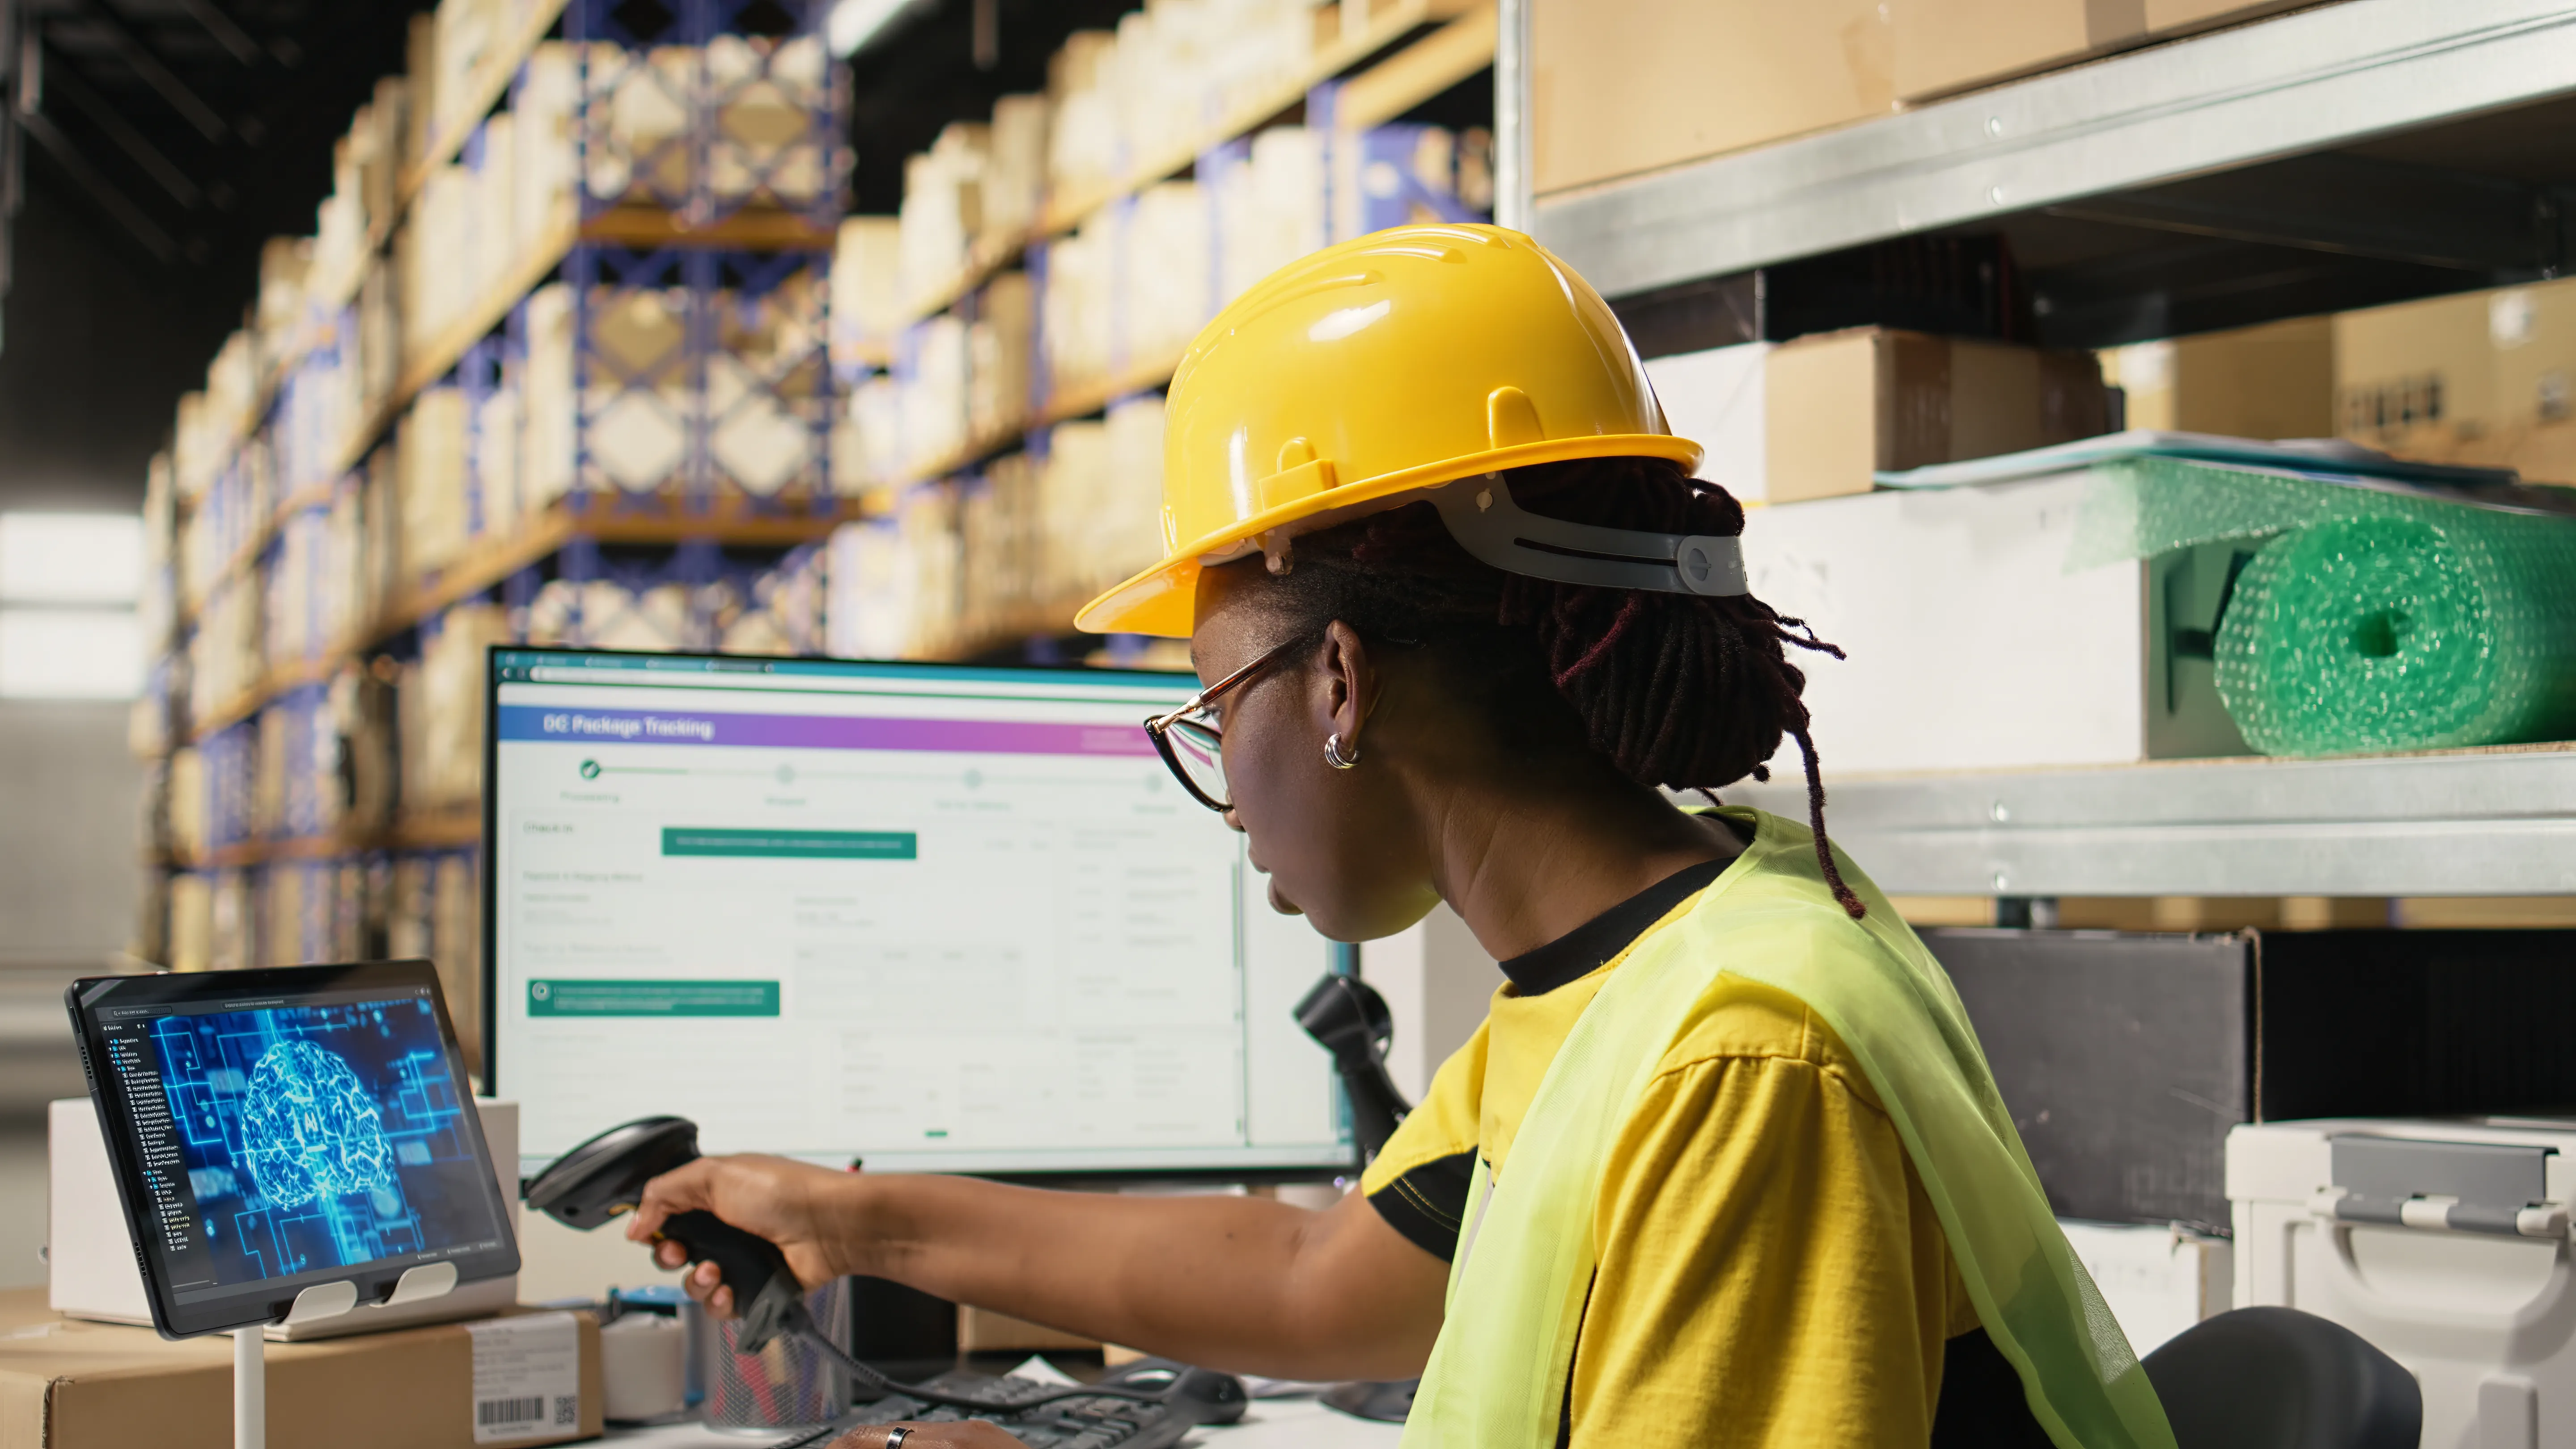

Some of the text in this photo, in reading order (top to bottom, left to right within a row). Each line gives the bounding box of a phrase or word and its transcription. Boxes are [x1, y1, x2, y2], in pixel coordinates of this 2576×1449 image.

[544, 714, 715, 741] DC Package Tracking
[305, 1111, 319, 1133] AI
